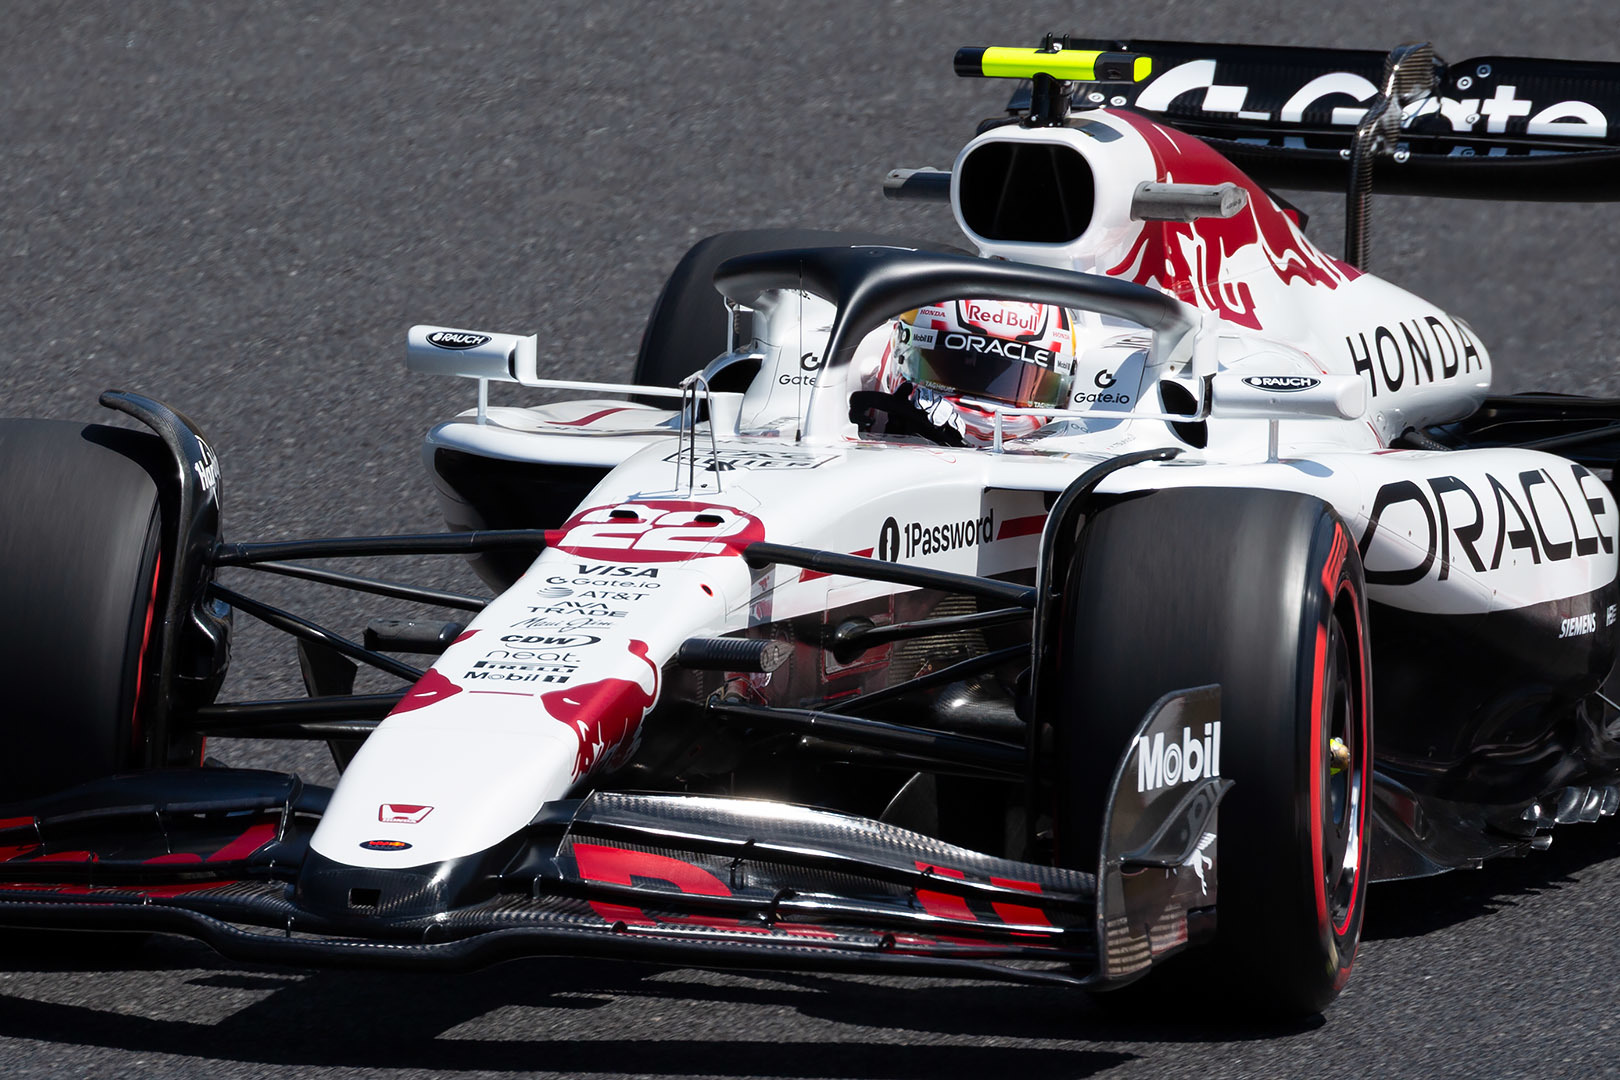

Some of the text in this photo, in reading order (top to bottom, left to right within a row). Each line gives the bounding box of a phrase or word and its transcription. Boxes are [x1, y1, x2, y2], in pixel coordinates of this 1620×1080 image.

[920, 309, 946, 318] HONDA
[968, 305, 1038, 331] Red Bull
[442, 332, 484, 345] RAUCH
[945, 333, 1050, 368] ORACLE
[1345, 316, 1482, 397] HONDA
[1262, 376, 1312, 388] RAUCH
[1074, 392, 1130, 405] Gate.io
[557, 503, 750, 554] 22
[1358, 464, 1614, 586] ORACLE
[904, 508, 994, 559] 1Password
[573, 564, 659, 578] VISA
[572, 578, 661, 589] Gate.io
[578, 590, 650, 601] AT&T
[527, 606, 629, 618] TRADE
[1559, 612, 1596, 639] SIEMENS
[500, 635, 578, 645] CDW
[463, 671, 540, 682] Mobil
[1137, 721, 1221, 792] Mobil
